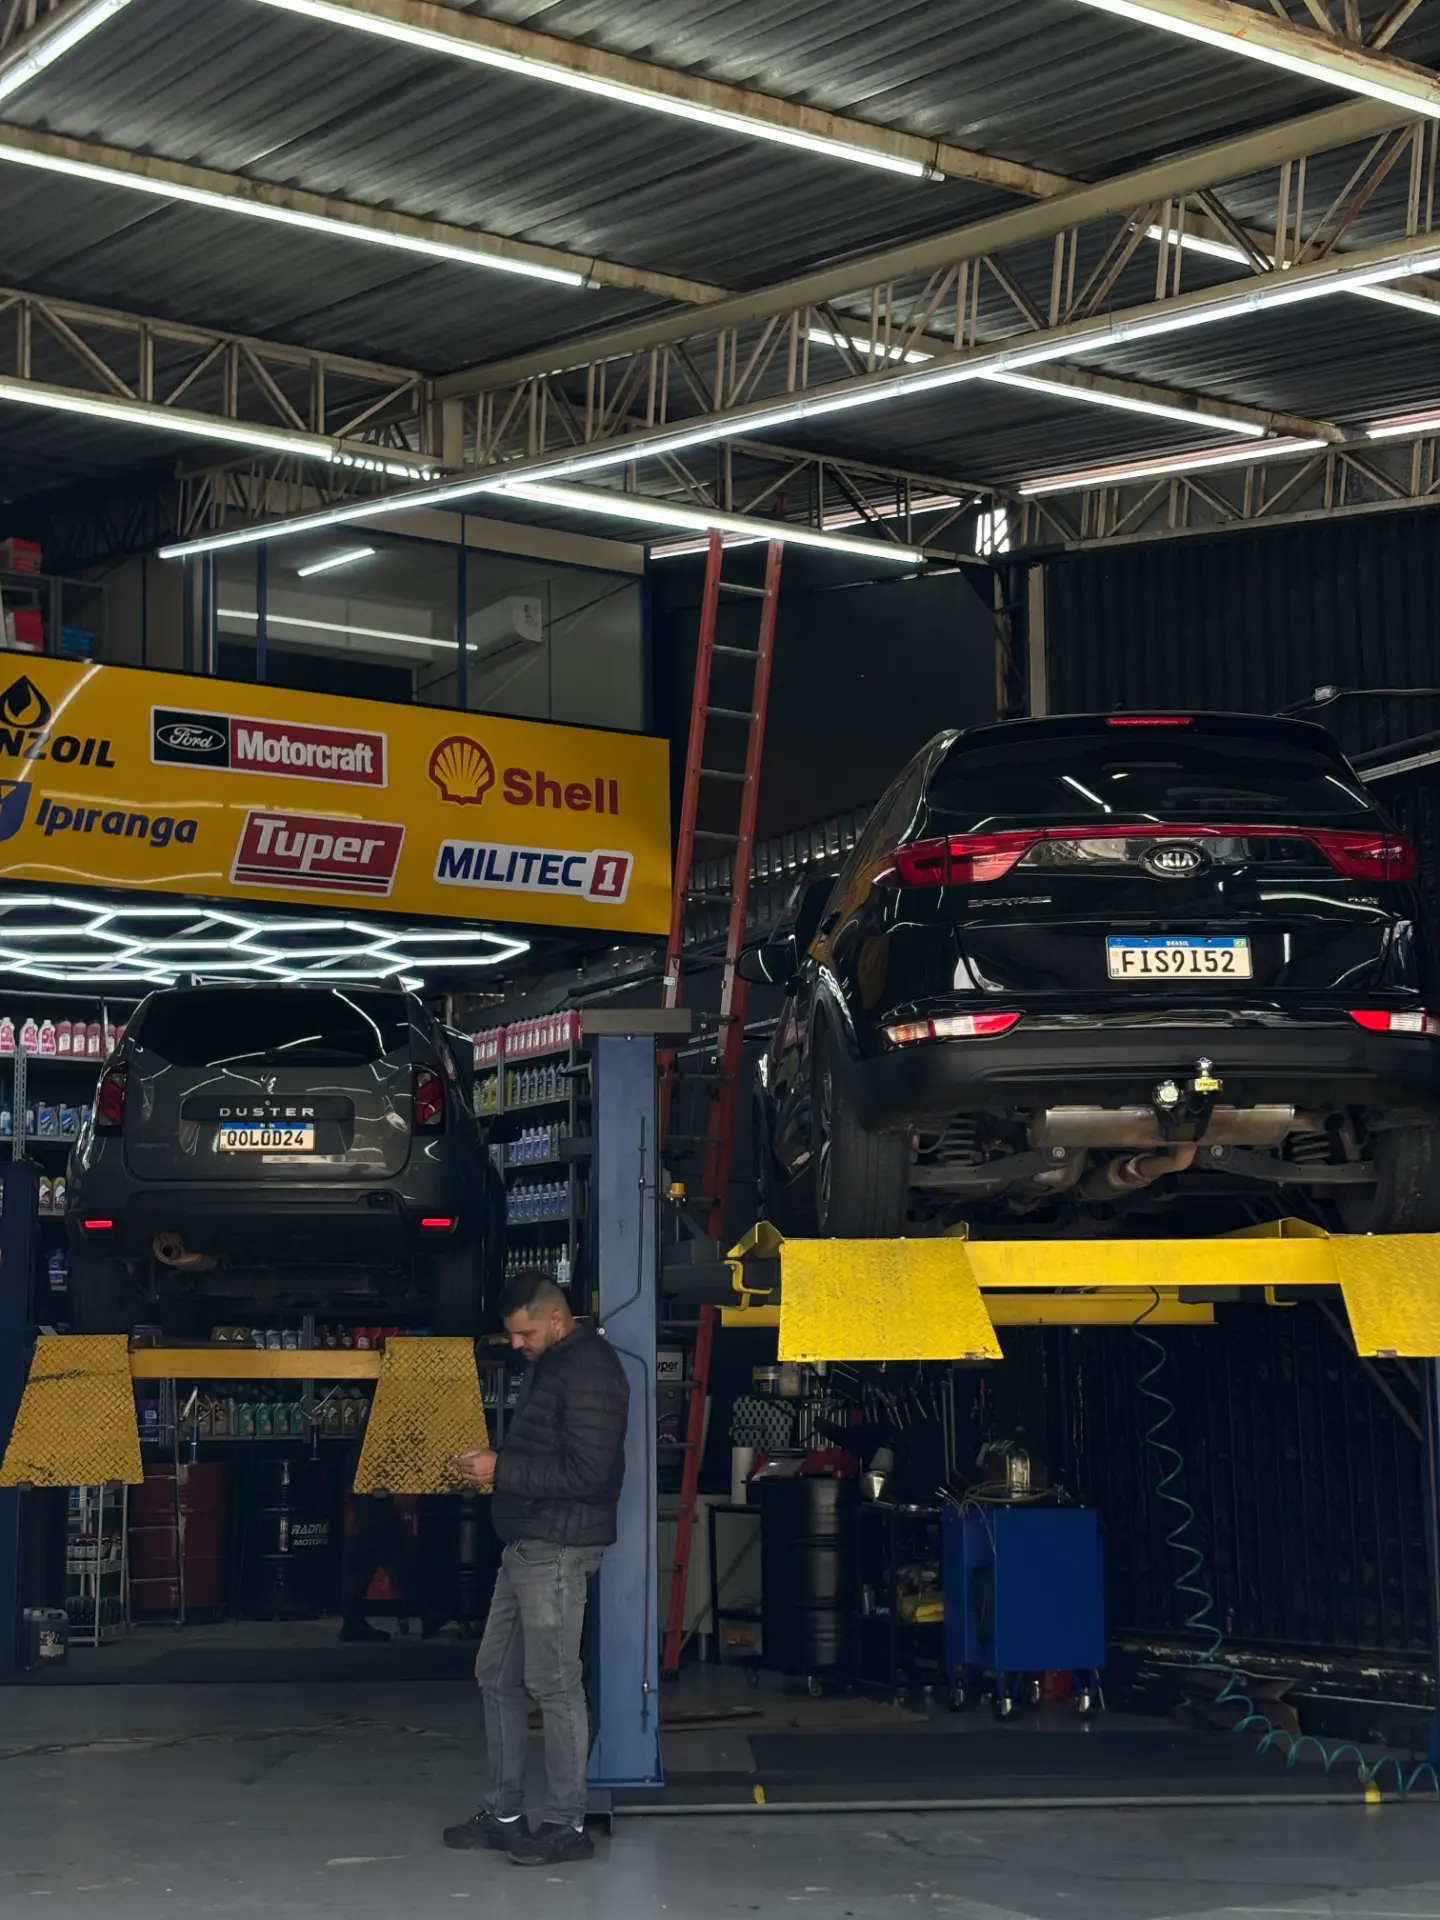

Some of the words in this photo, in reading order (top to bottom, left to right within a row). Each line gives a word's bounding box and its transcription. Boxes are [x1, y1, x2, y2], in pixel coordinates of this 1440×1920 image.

[169, 727, 214, 748] Ford
[237, 729, 373, 774] Motorcraft
[503, 768, 619, 815] Shell
[35, 798, 198, 847] Ipiranga
[253, 818, 386, 872] Tuper
[437, 846, 587, 887] MILITEC
[598, 861, 617, 892] 1
[1162, 852, 1194, 867] KIA
[219, 1107, 315, 1117] DUSTER
